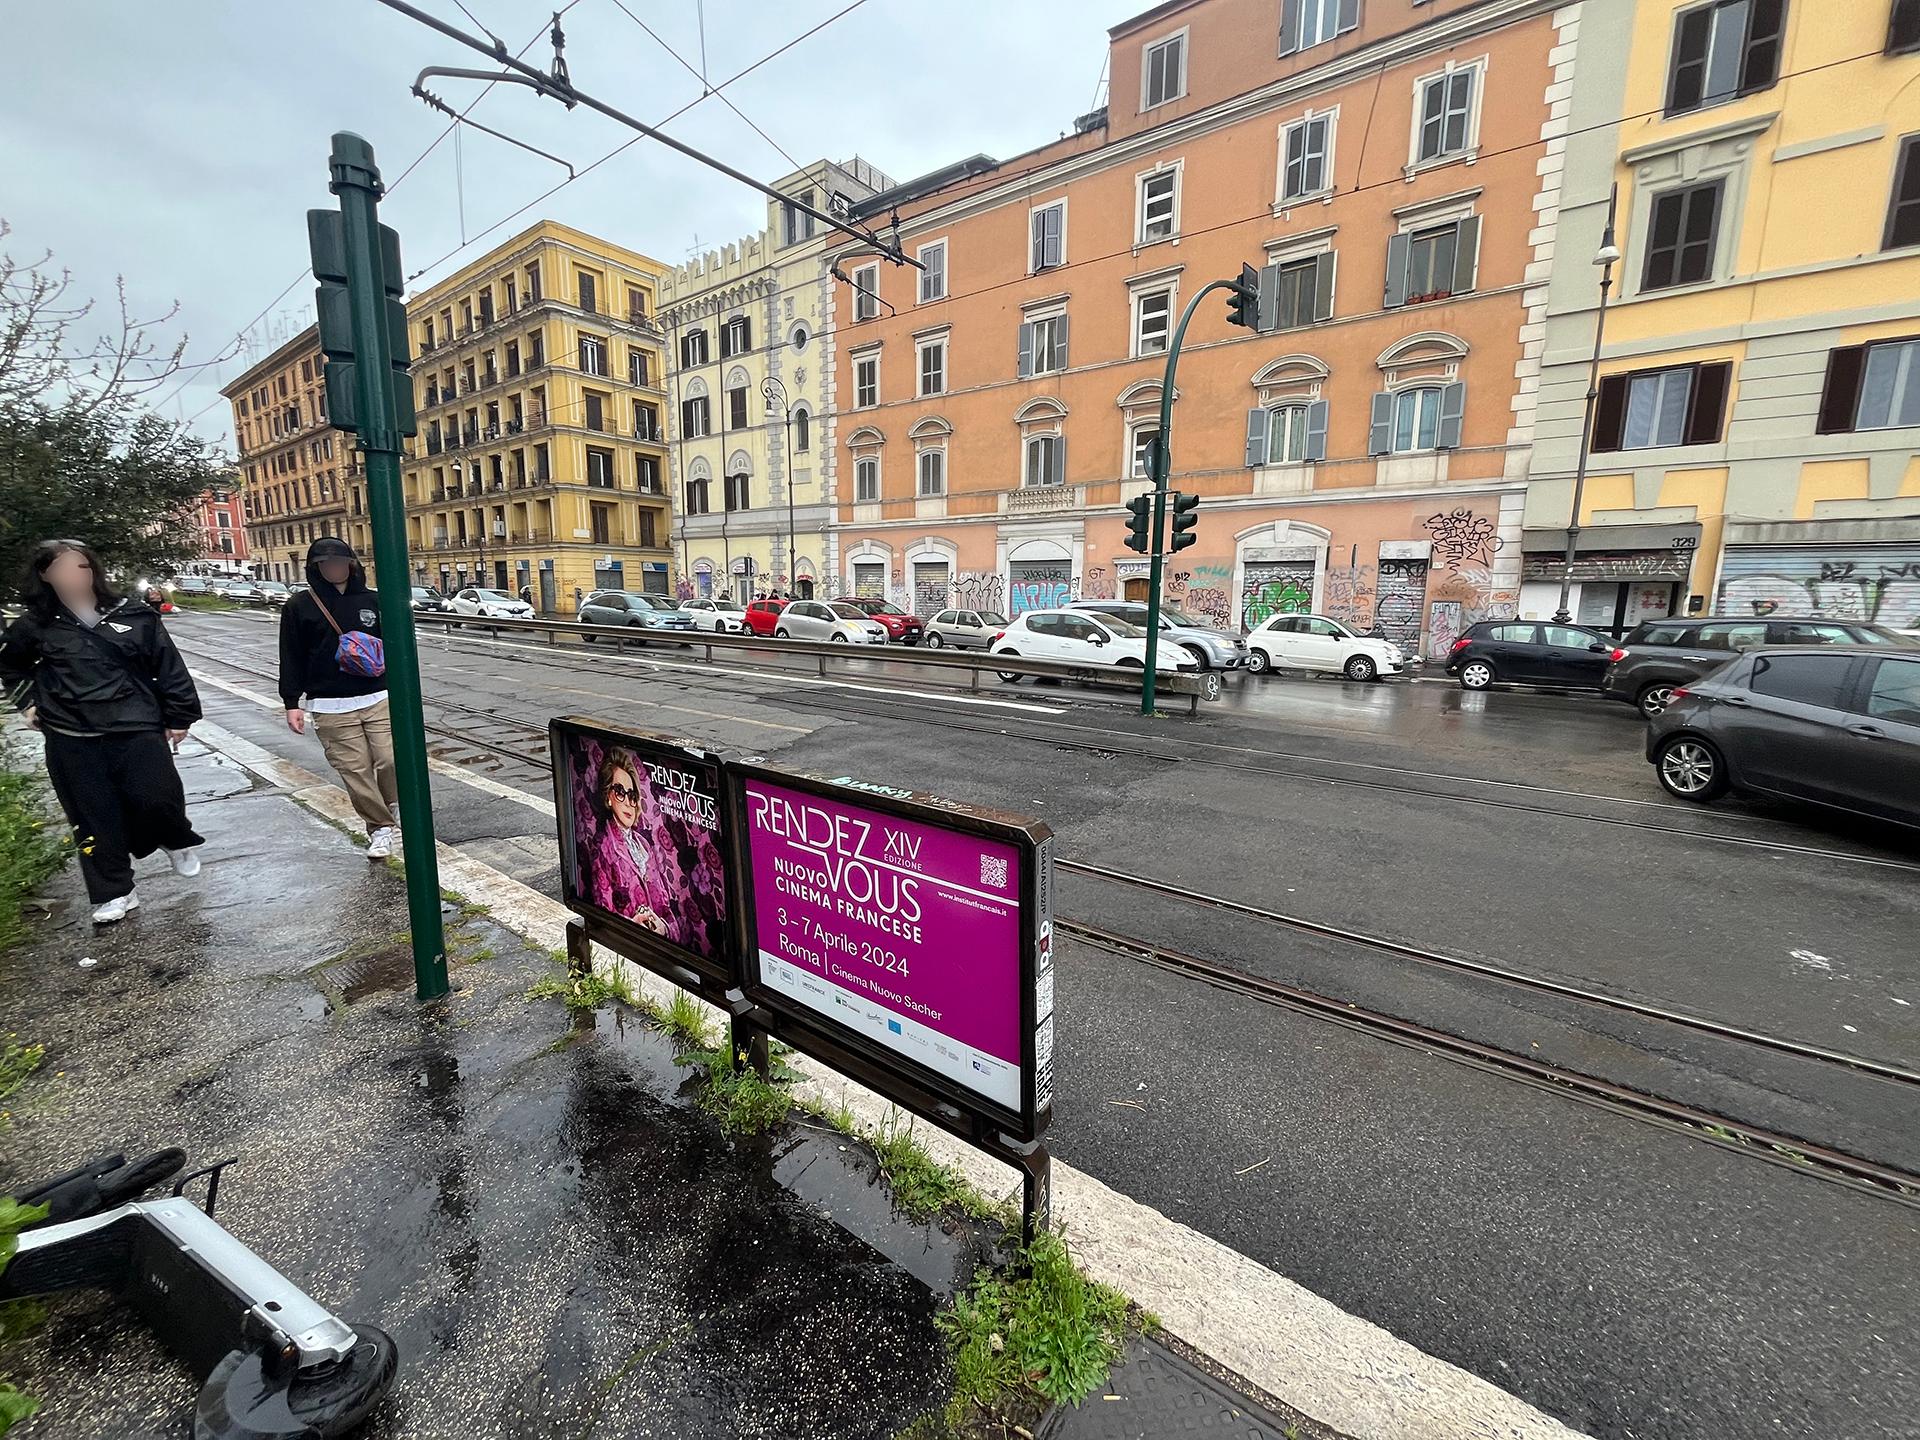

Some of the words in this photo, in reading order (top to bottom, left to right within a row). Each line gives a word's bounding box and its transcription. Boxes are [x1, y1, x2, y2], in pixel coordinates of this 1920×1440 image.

[1672, 537, 1696, 548] 329
[643, 762, 696, 793] RENDEZ
[659, 795, 681, 810] NUOVO
[659, 804, 683, 820] CINEMA
[683, 812, 717, 831] FRANCESE
[679, 791, 716, 820] VOUS
[746, 790, 871, 860] RENDEZ
[883, 827, 922, 860] XIV
[774, 856, 827, 888] NUOVO
[883, 853, 922, 871] EDIZIONE
[823, 852, 922, 923] VOUS
[775, 877, 832, 910] CINEMA
[837, 900, 922, 944] FRANCESE
[813, 921, 858, 956] Aprile
[861, 941, 910, 978] 2024
[779, 933, 820, 967] Roma
[832, 963, 868, 989] Cinema
[869, 978, 902, 1004] Nuovo
[904, 995, 942, 1021] Sacher
